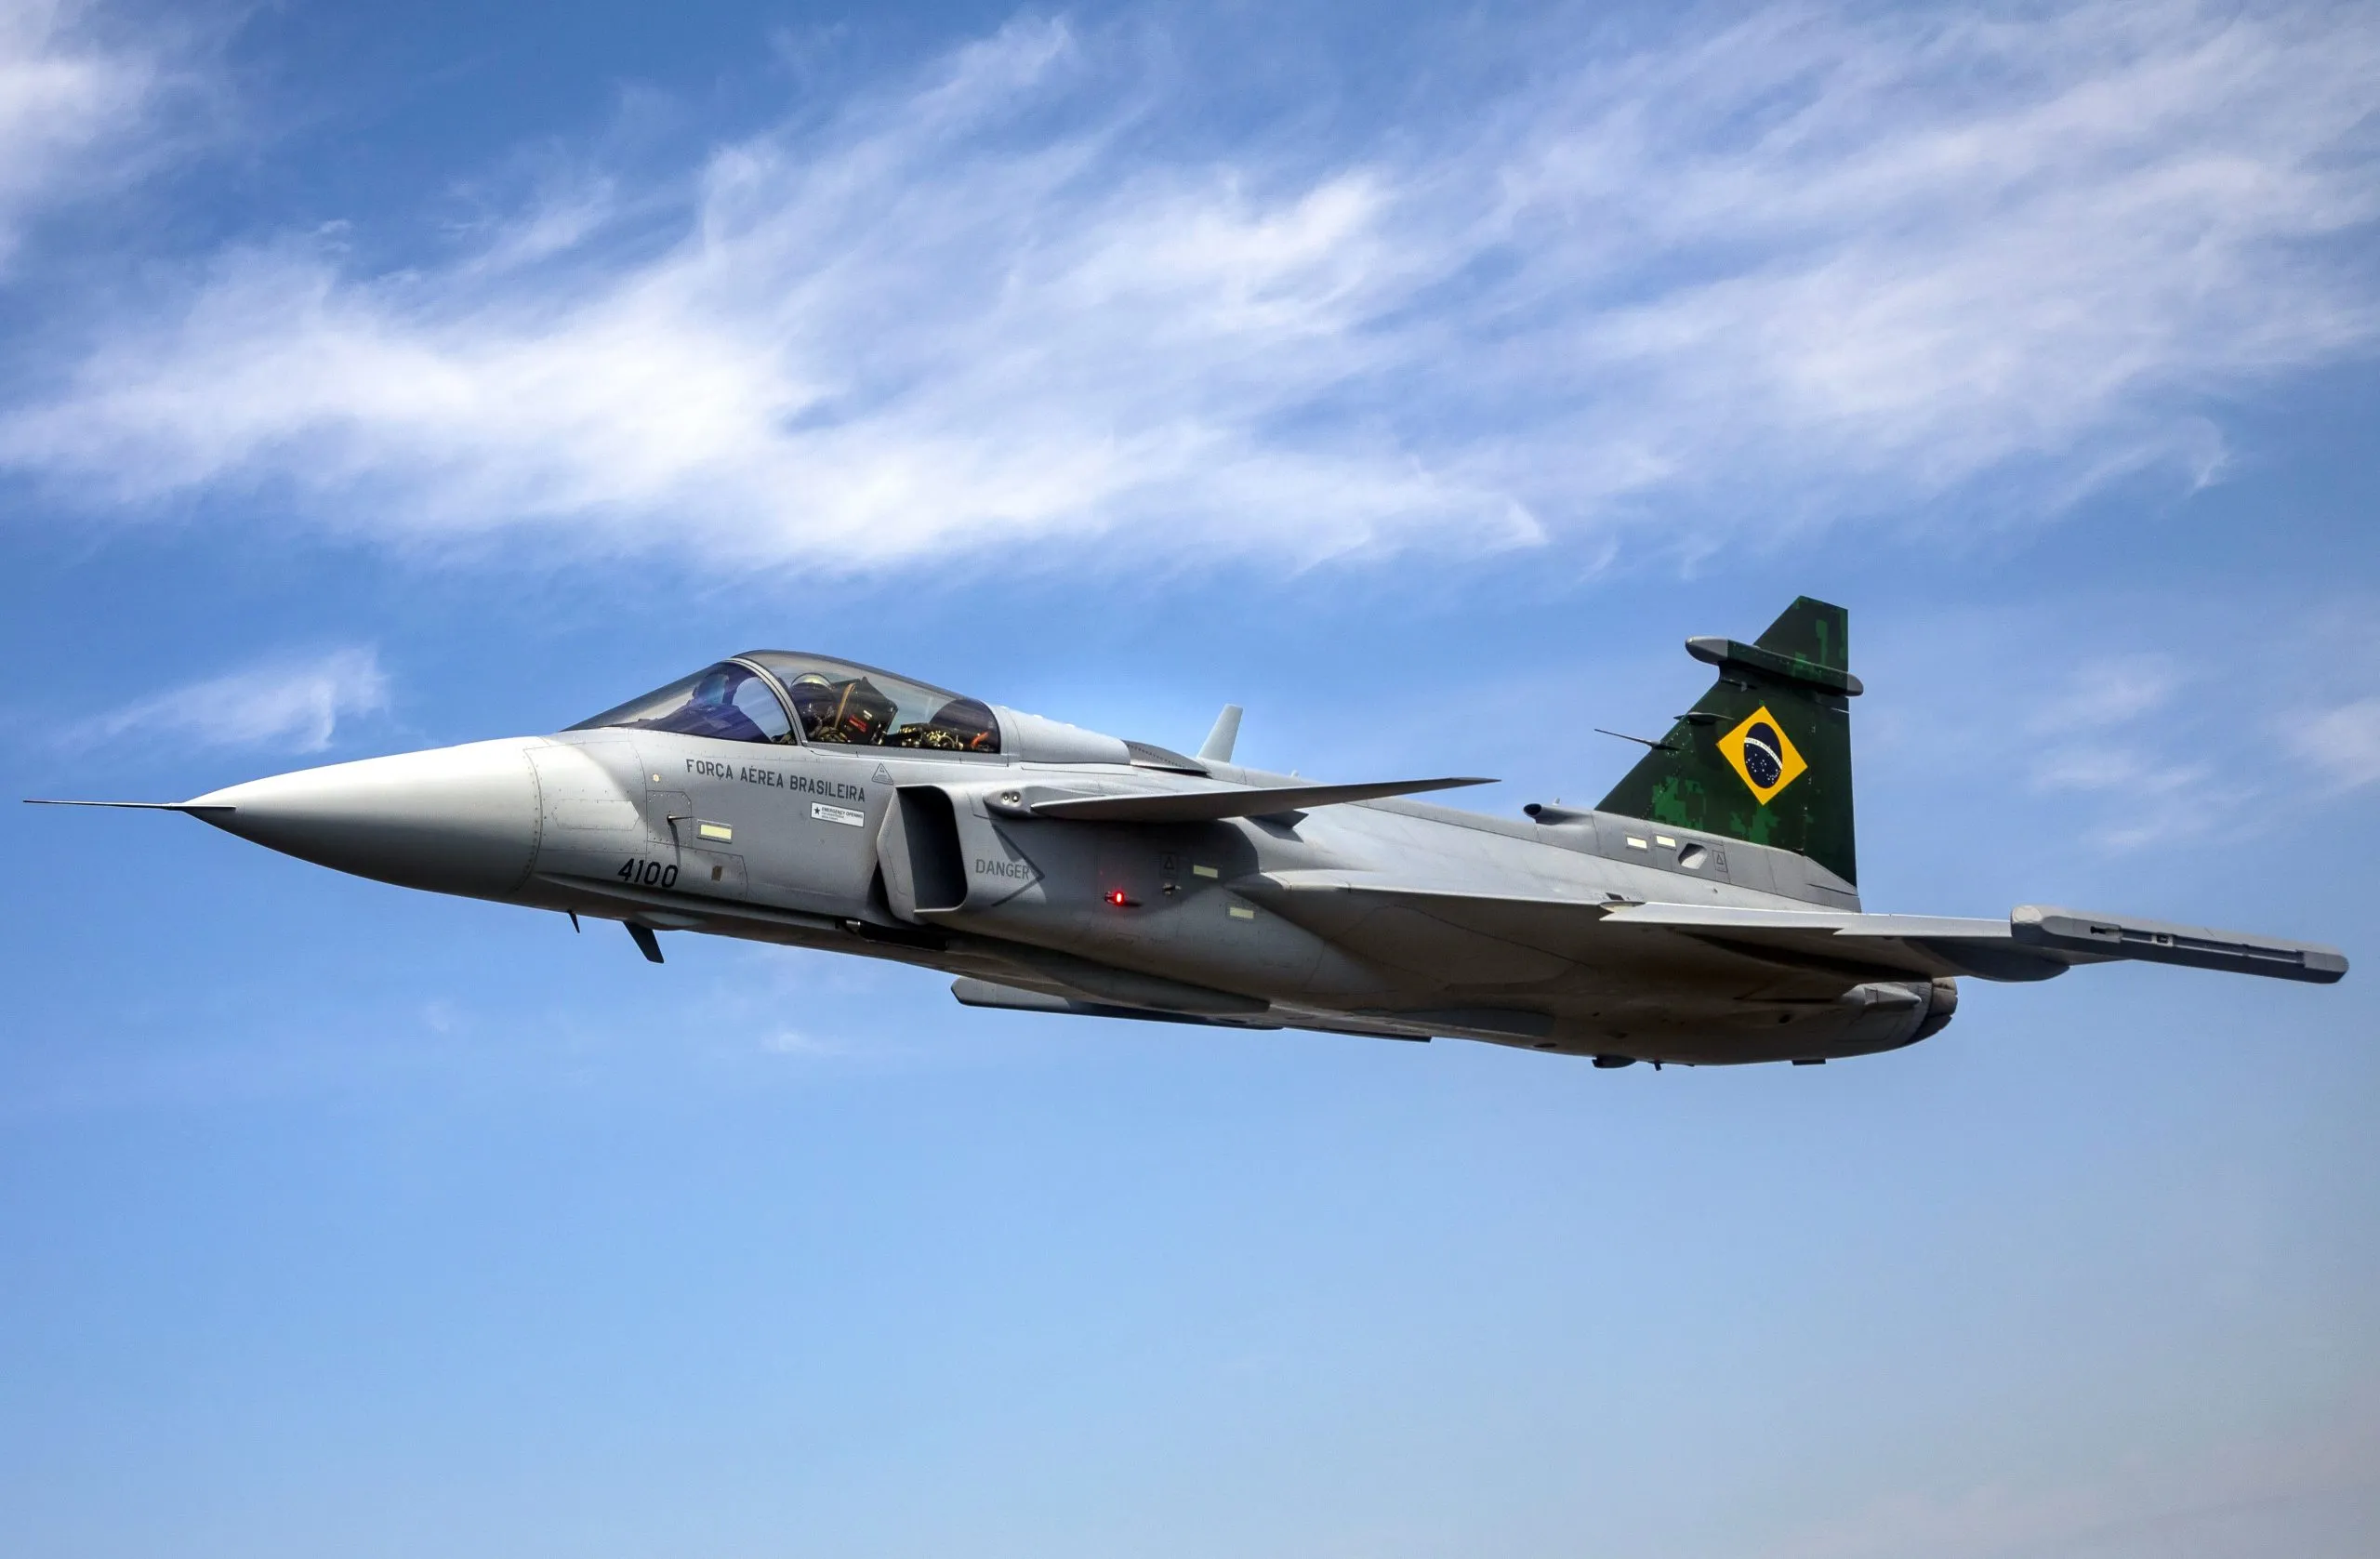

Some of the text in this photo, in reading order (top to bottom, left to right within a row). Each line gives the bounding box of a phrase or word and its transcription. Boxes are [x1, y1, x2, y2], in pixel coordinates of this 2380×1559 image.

[686, 759, 734, 781] FORÇA
[740, 765, 784, 788] AÉREA
[790, 774, 866, 802] BRASILEIRA
[821, 806, 845, 816] EMERGENCY
[617, 858, 679, 889] 4100
[975, 858, 1029, 880] DANGER
